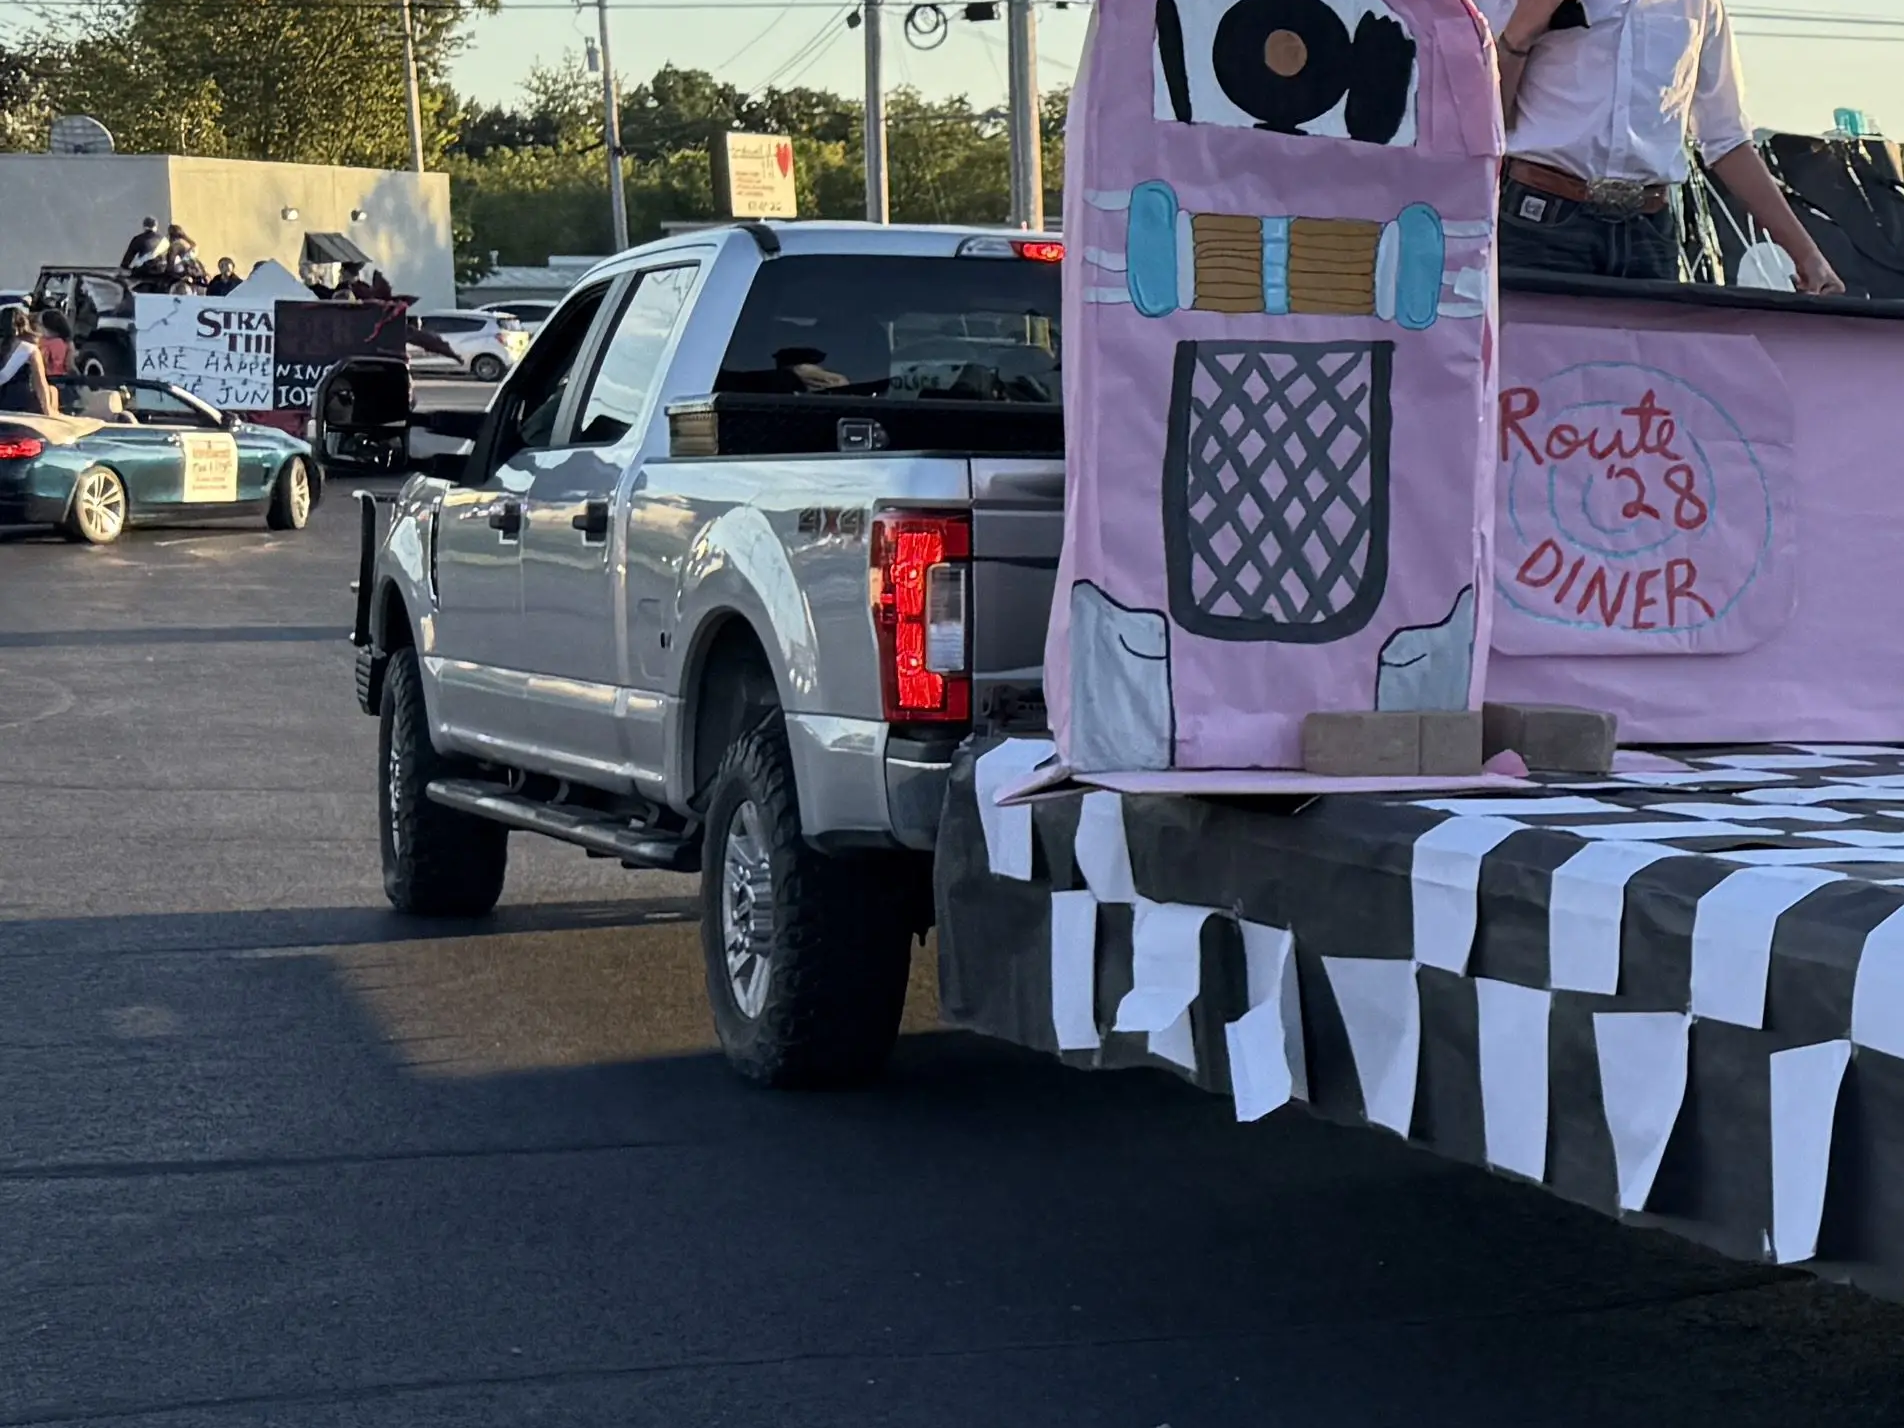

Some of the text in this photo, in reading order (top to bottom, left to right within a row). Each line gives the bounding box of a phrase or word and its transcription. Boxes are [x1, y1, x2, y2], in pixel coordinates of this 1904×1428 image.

[141, 350, 188, 371] ARE
[1498, 387, 1684, 465] Route
[1606, 464, 1708, 530] '28
[1515, 538, 1716, 630] DINER
